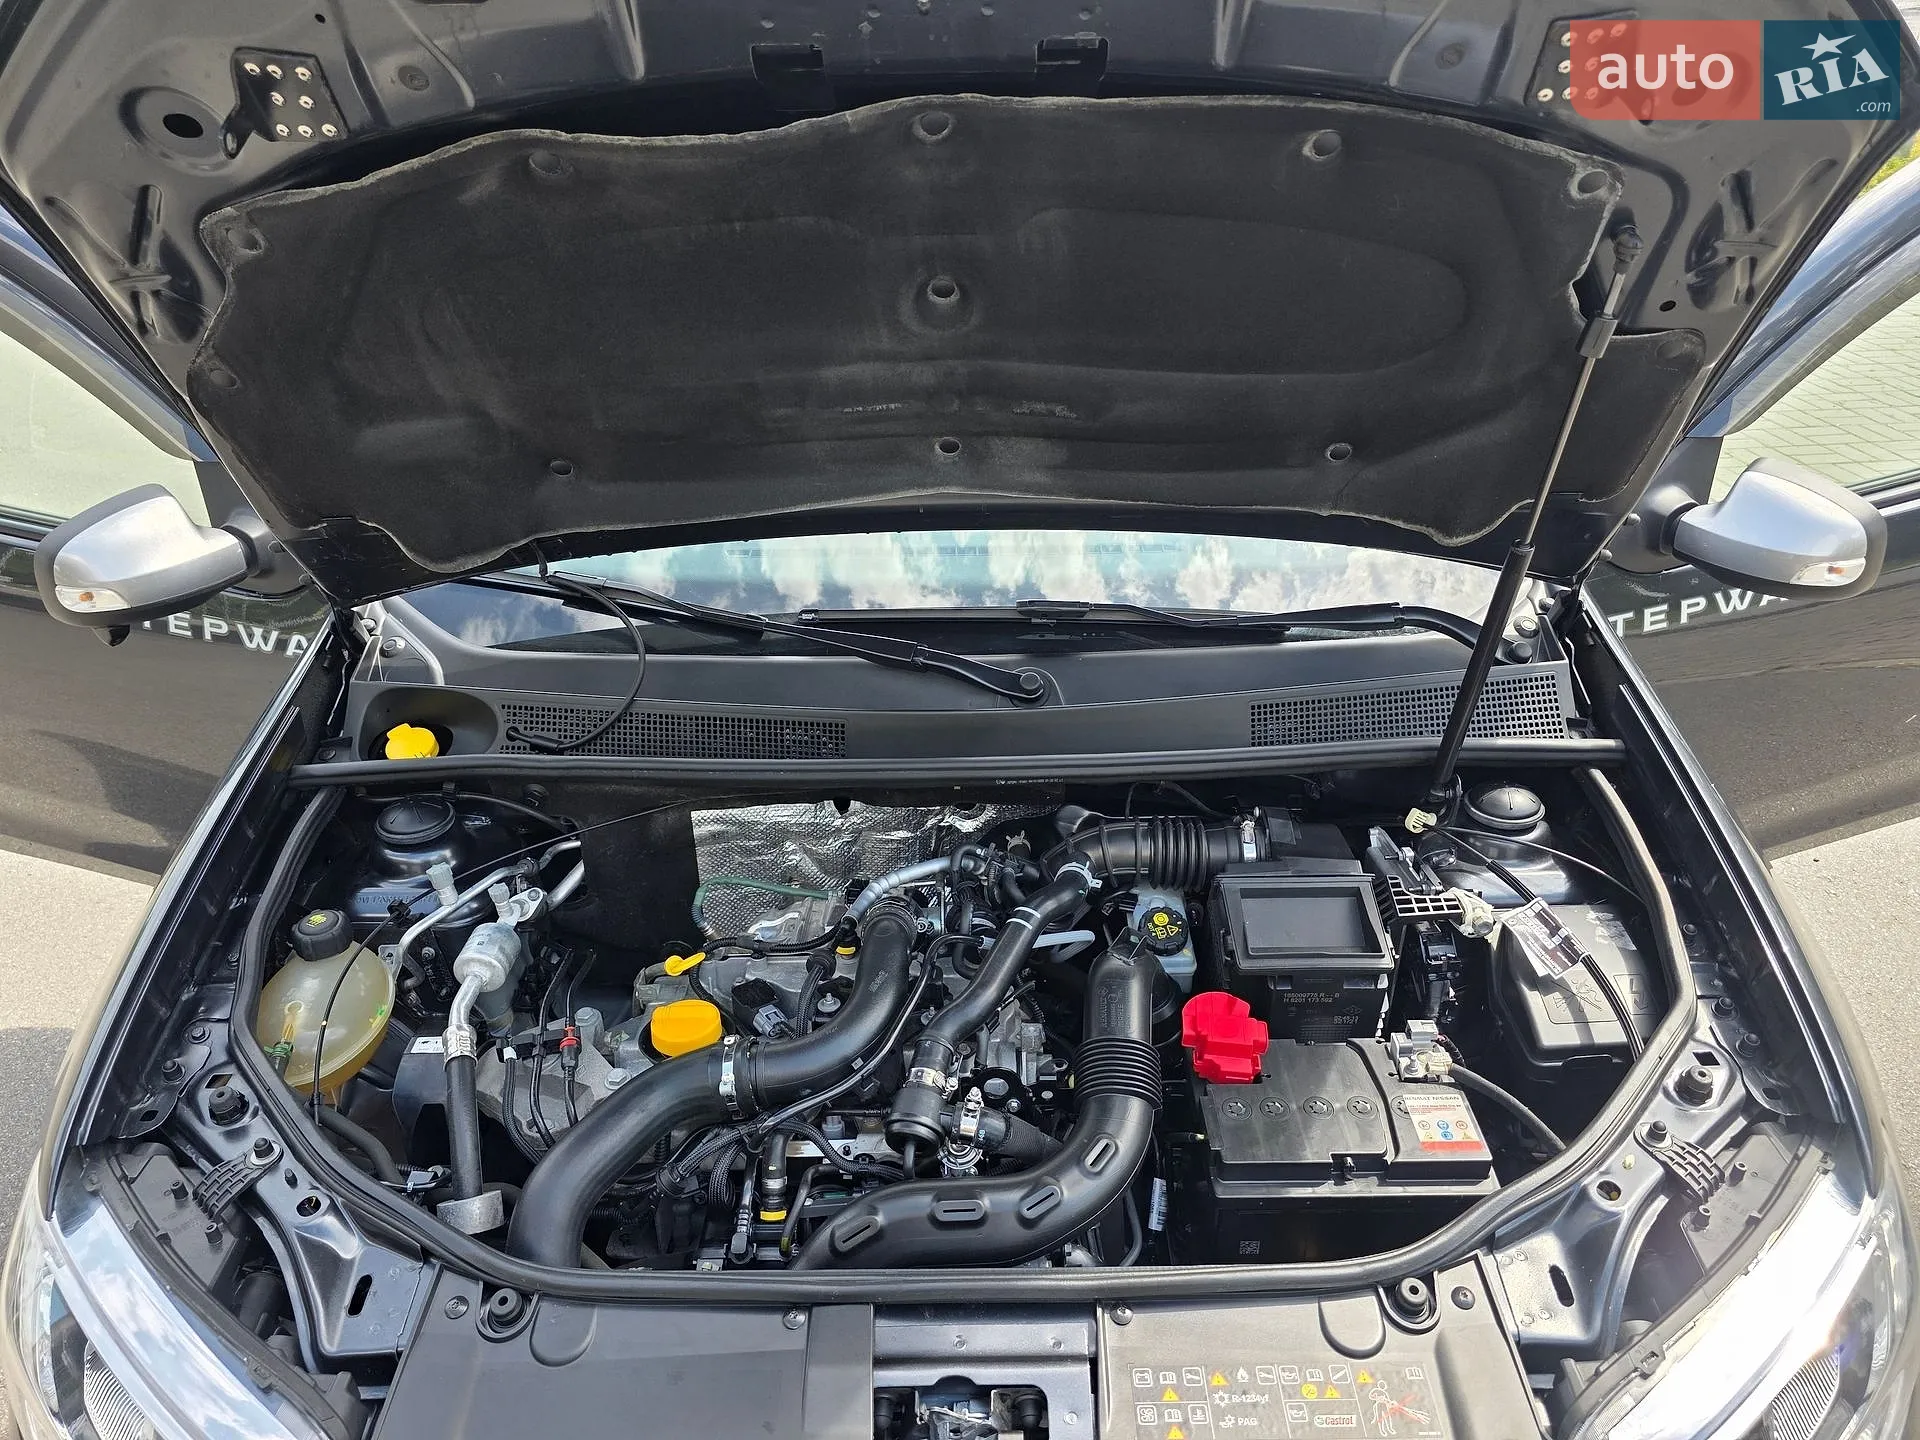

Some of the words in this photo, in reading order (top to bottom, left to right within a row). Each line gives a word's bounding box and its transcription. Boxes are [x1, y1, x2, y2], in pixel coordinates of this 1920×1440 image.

[1606, 587, 1791, 638] TEPW
[1237, 1417, 1258, 1426] PAG
[1324, 1415, 1354, 1426] Castrol
